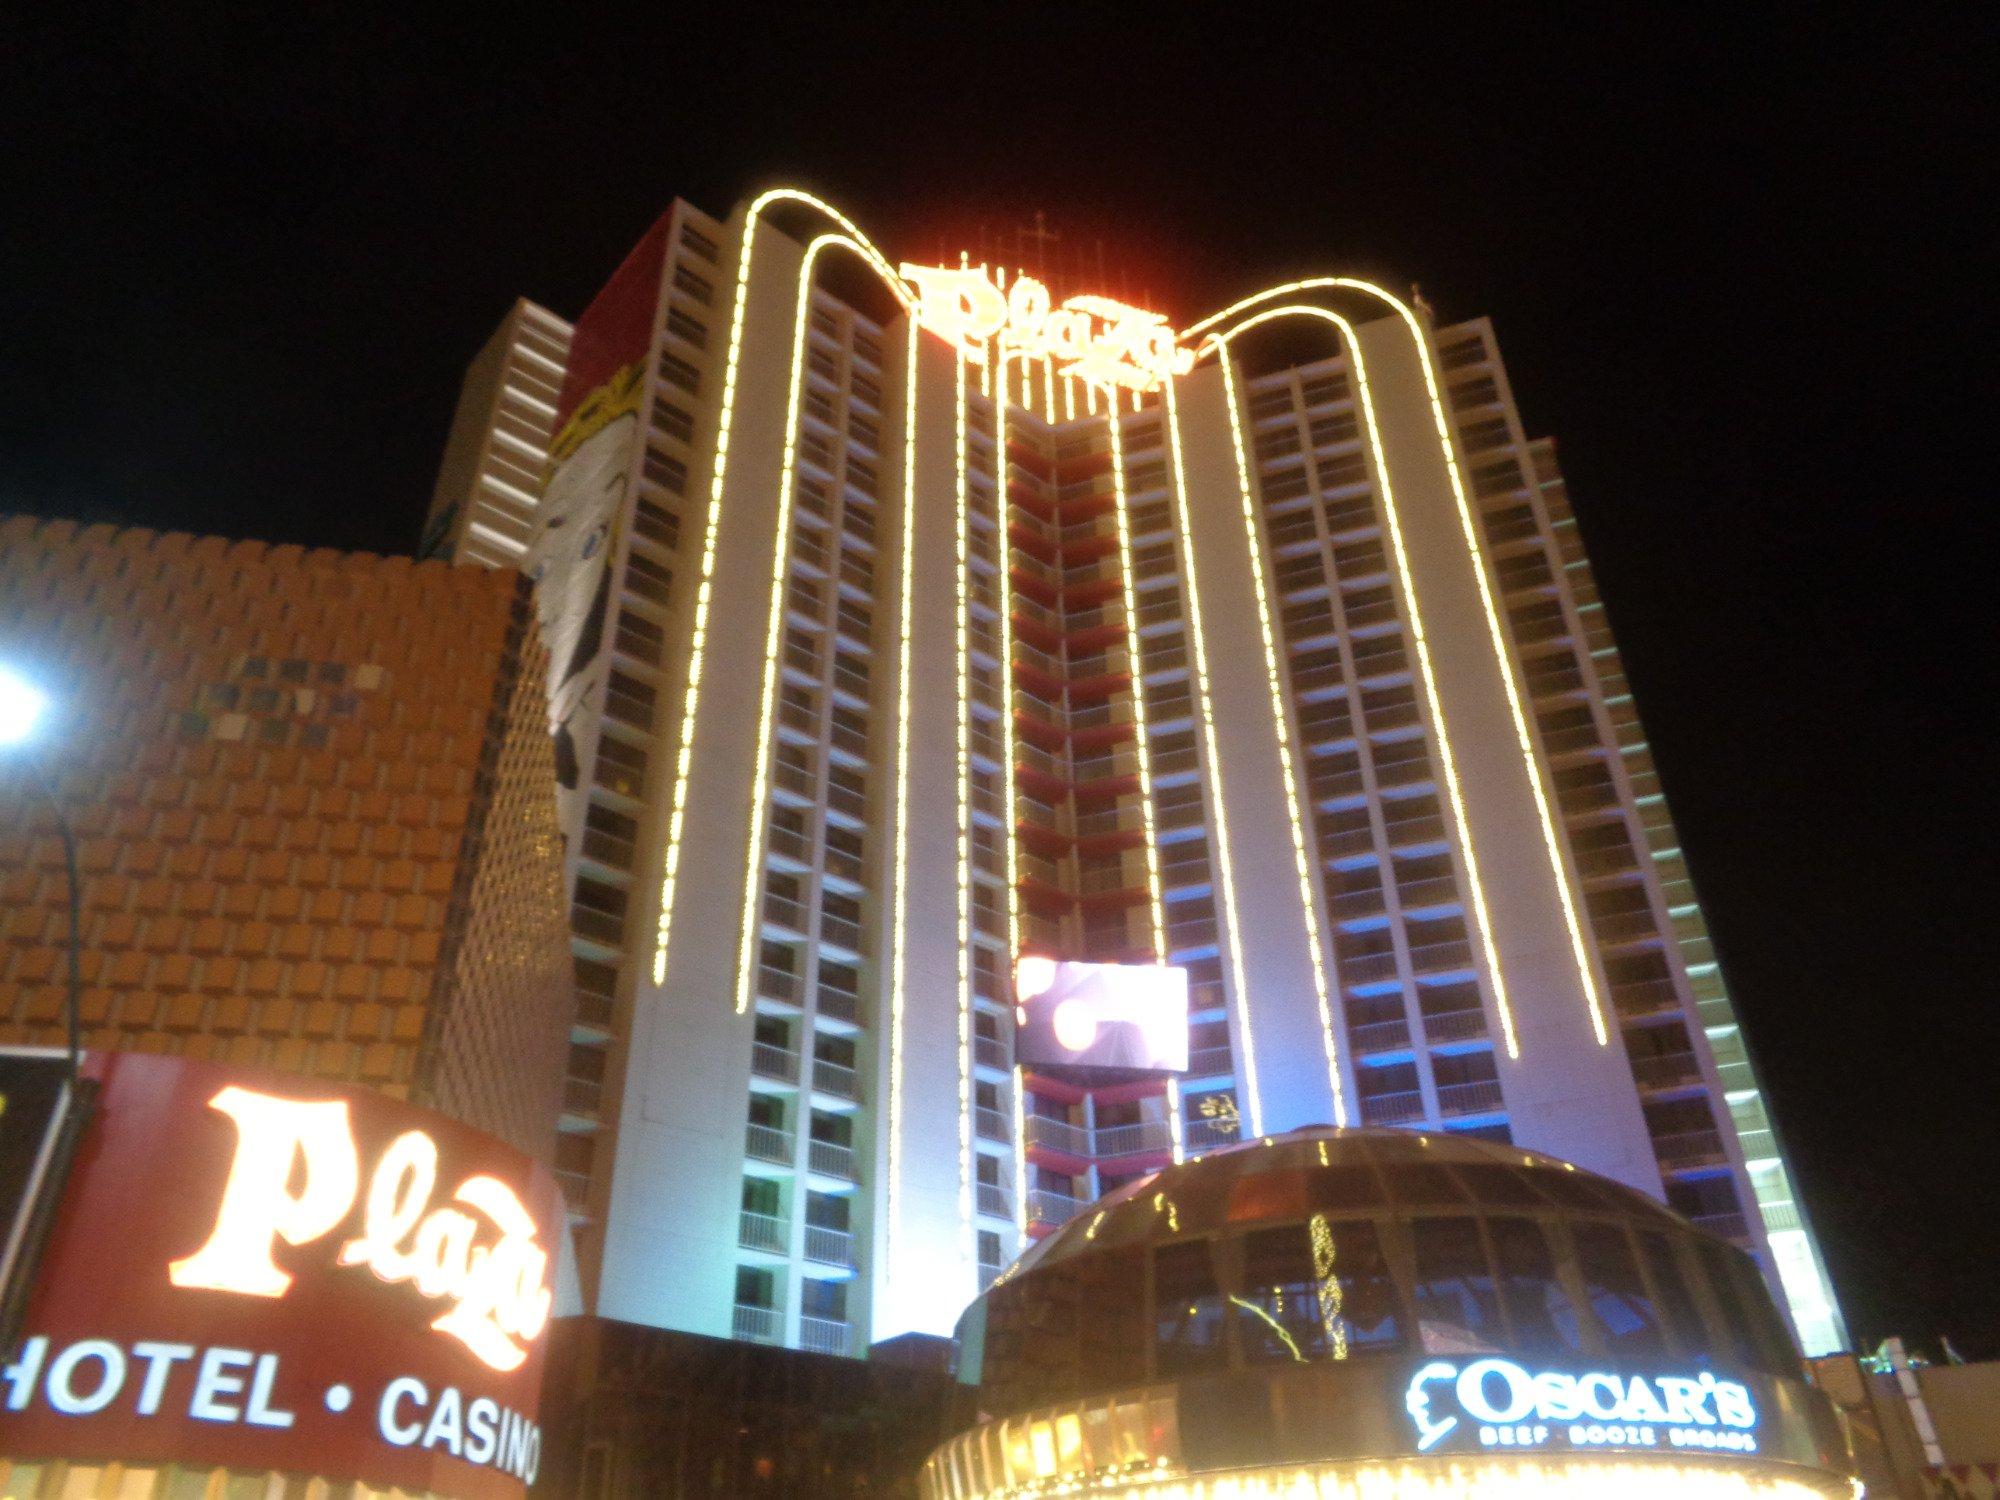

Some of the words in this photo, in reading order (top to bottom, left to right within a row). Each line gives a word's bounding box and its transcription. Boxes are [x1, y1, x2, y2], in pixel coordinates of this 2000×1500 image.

[899, 262, 1195, 391] Plaza
[169, 1086, 550, 1371] Plaza
[378, 1377, 542, 1486] CASINO
[1479, 1425, 1548, 1446] BEEF
[1569, 1424, 1656, 1446] BOOZE
